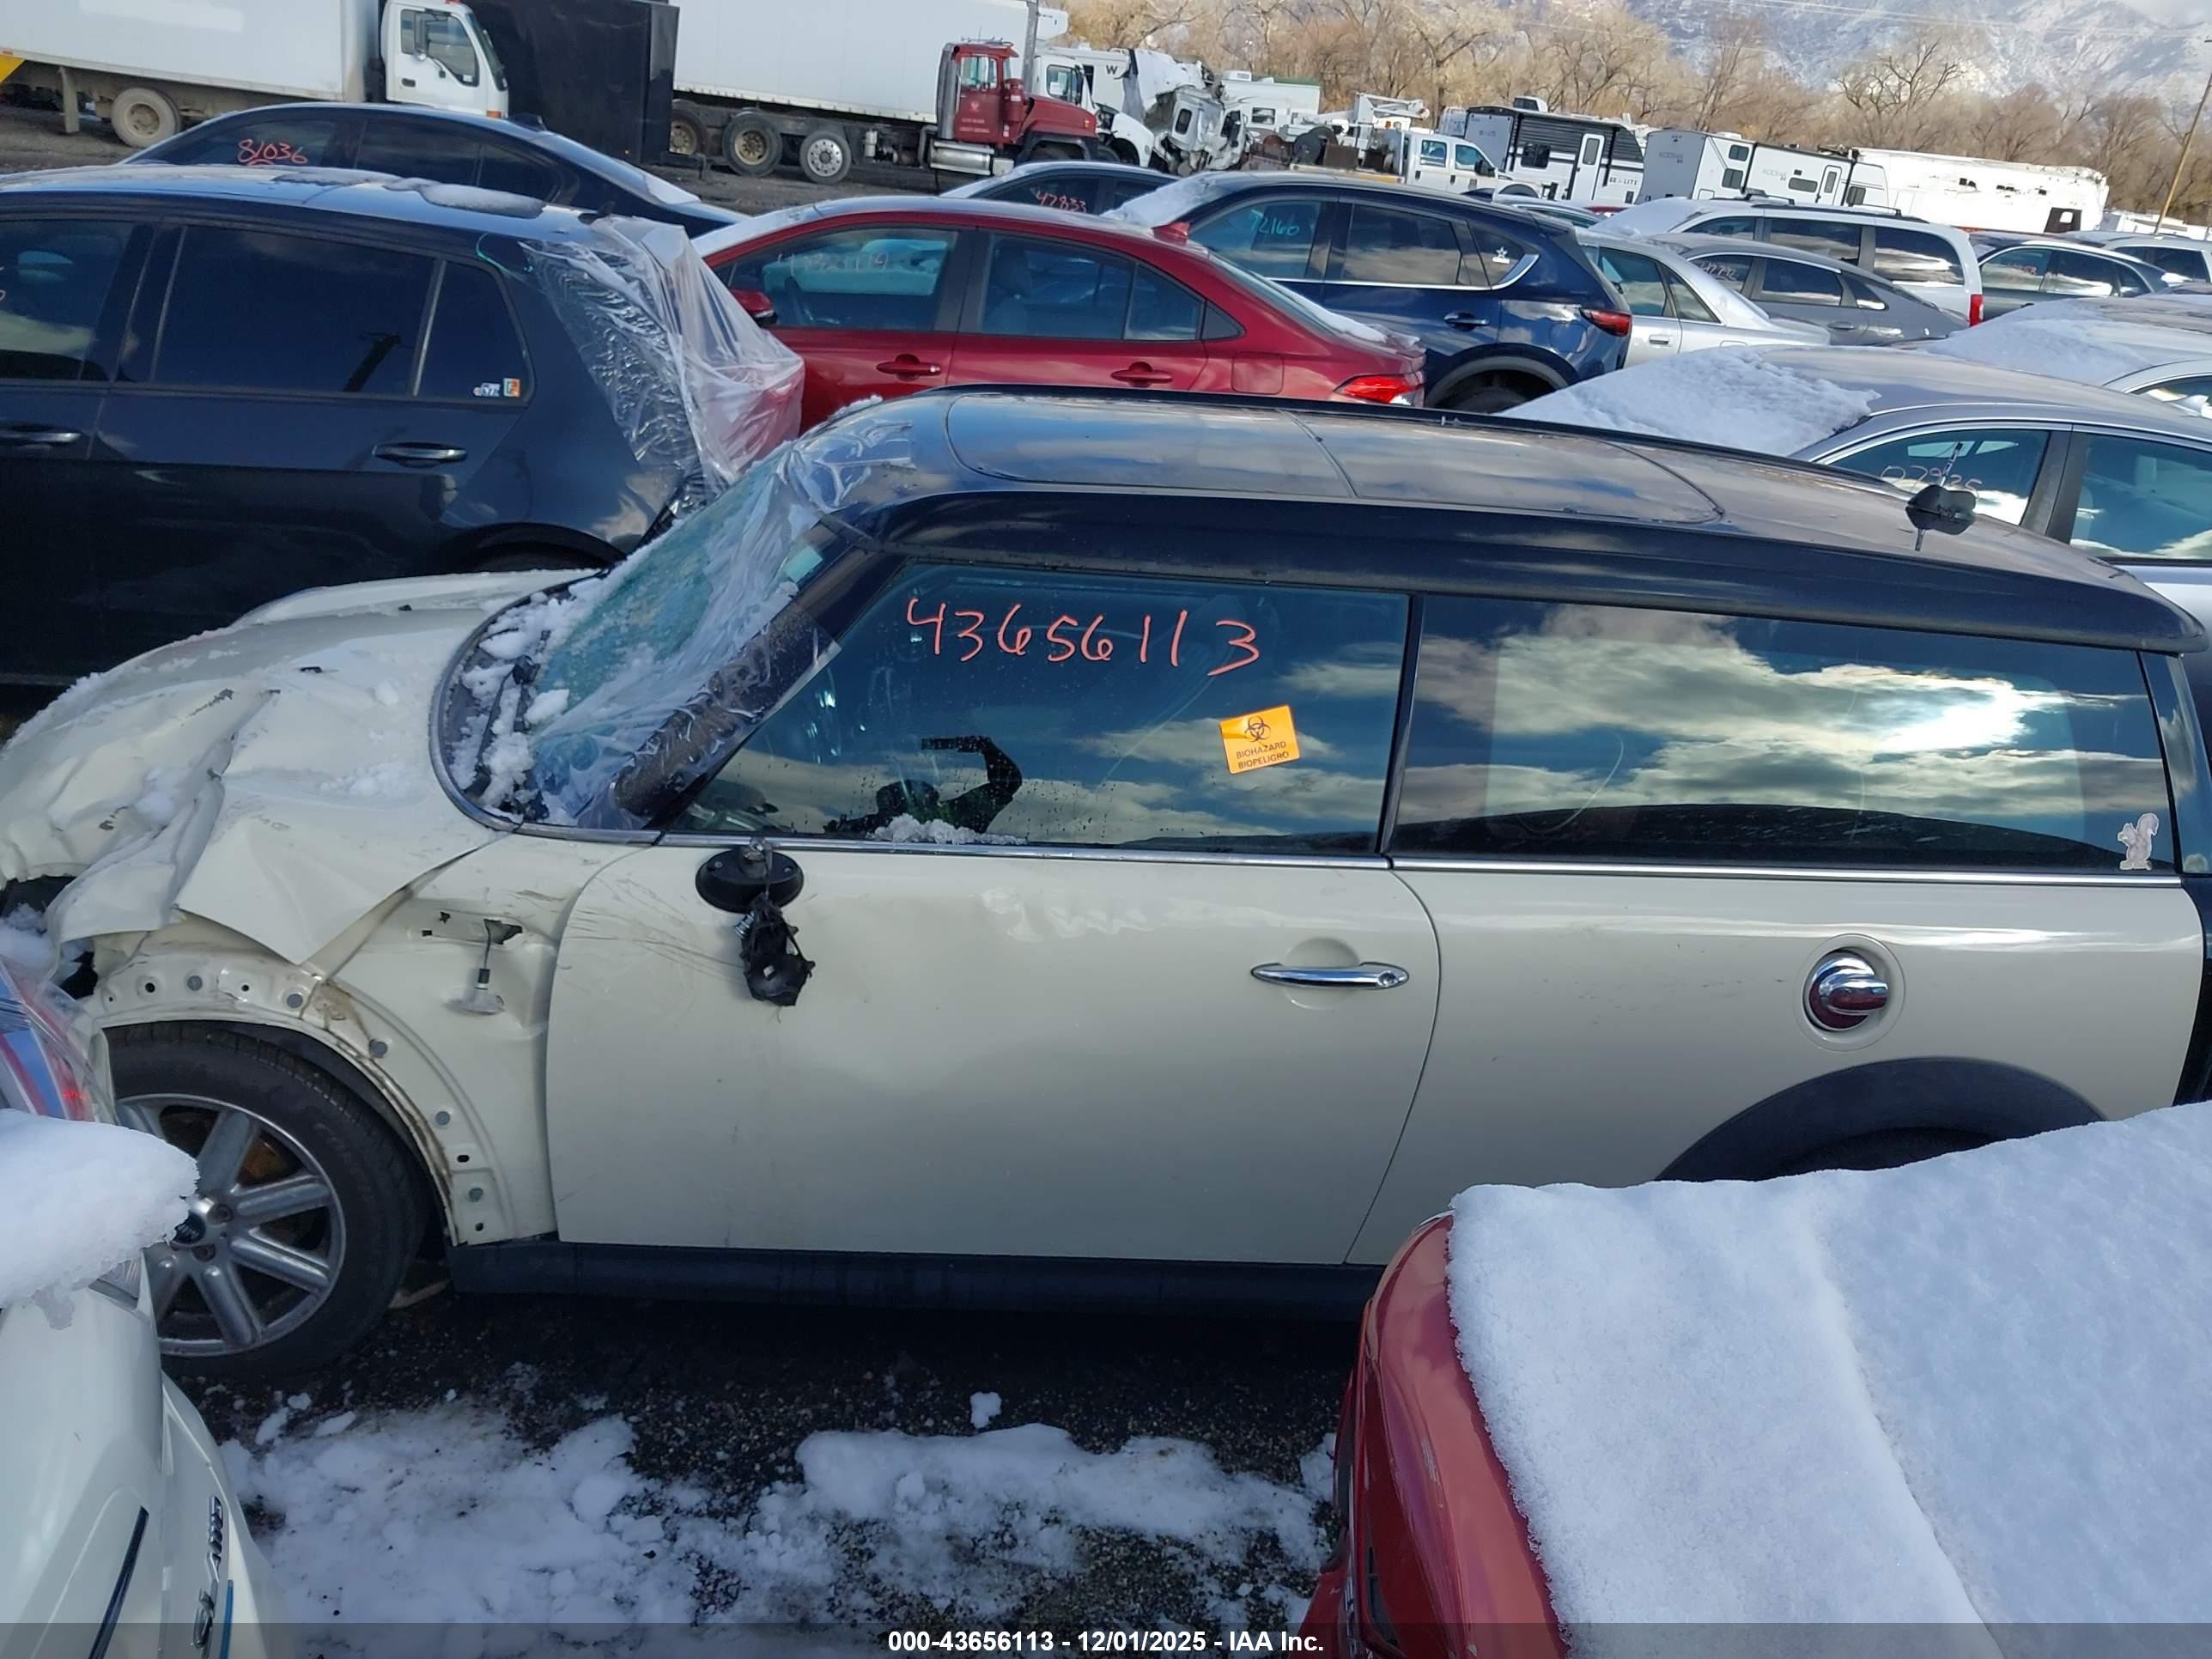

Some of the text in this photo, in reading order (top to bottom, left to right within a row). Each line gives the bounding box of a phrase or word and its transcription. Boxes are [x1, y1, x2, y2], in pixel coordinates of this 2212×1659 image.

[237, 138, 308, 164] 81036
[1250, 209, 1301, 236] 72160
[906, 598, 1261, 677] 43656113
[1236, 740, 1287, 760] BIOHAZARD
[1237, 750, 1290, 769] BIOPELIGRO
